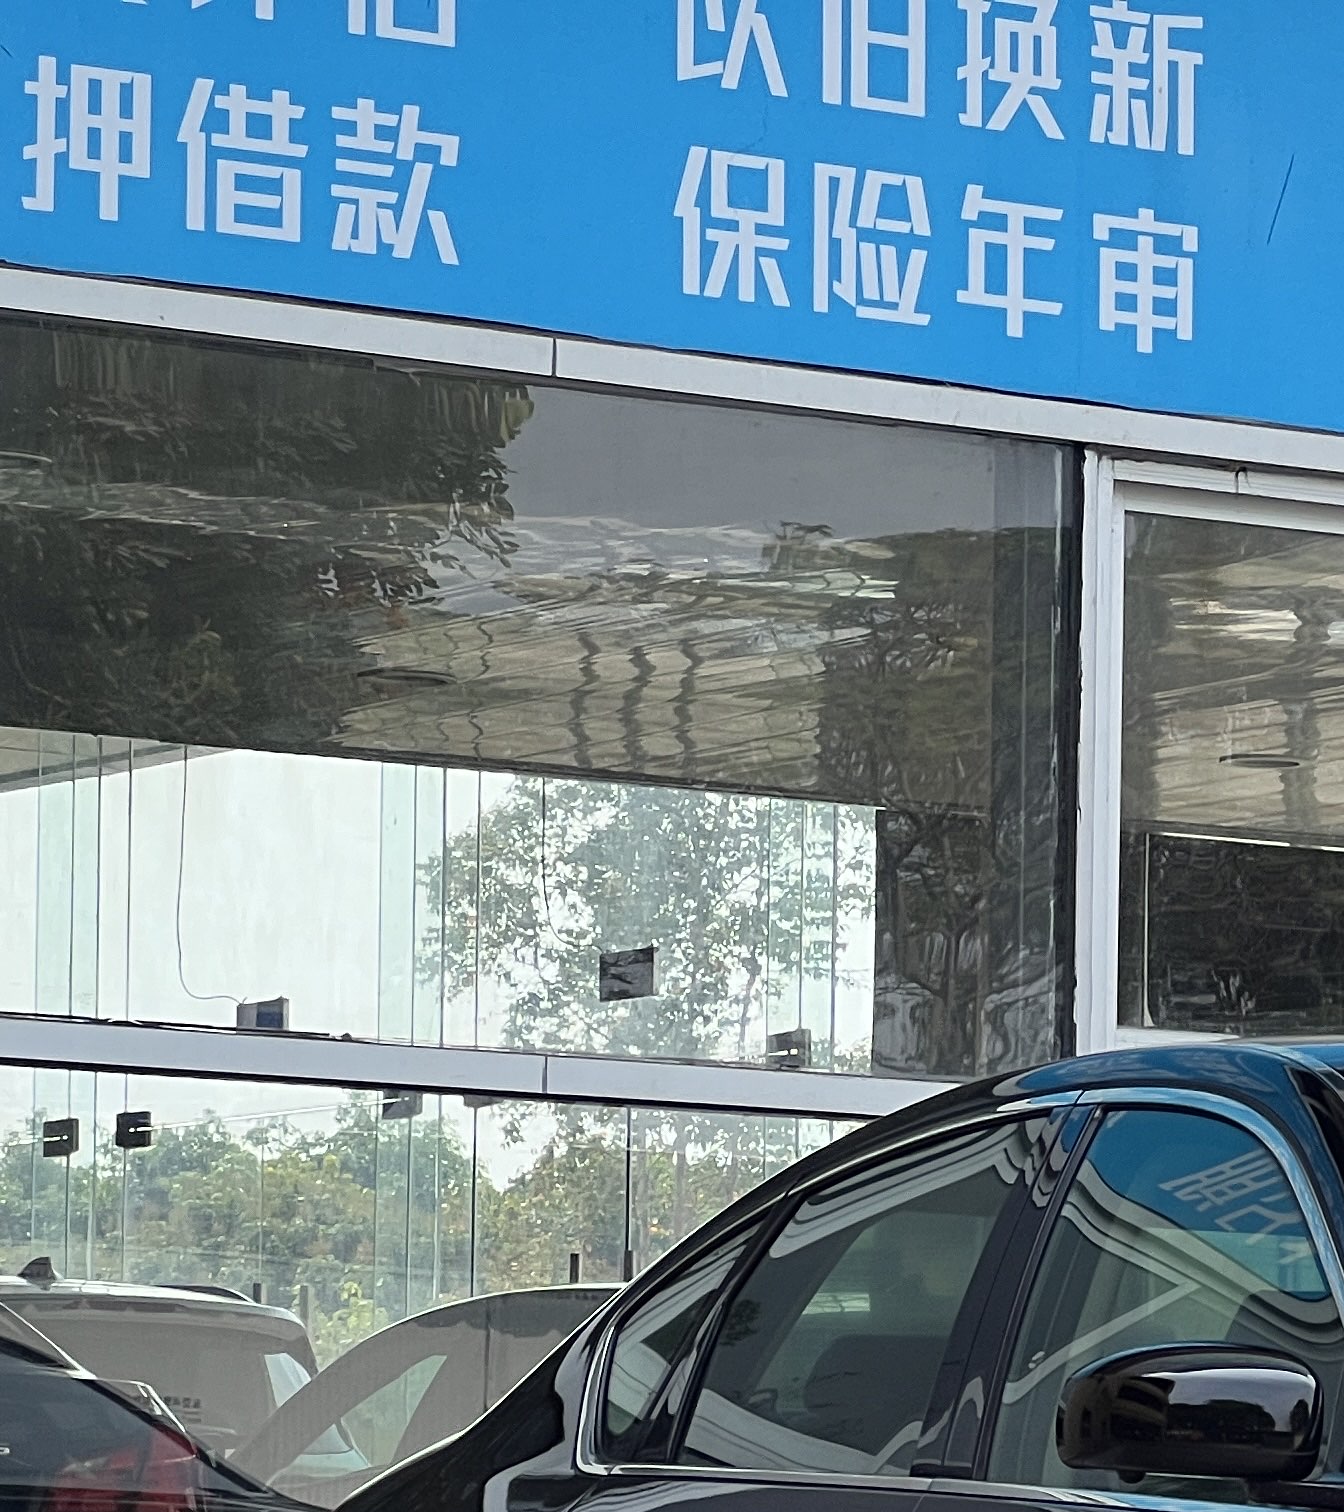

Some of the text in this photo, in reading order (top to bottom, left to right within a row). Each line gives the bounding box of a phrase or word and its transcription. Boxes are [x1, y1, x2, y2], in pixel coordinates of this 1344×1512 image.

[22, 54, 462, 267] 押借款
[675, 0, 1204, 157] 以旧换新
[672, 145, 1201, 355] 保险年审
